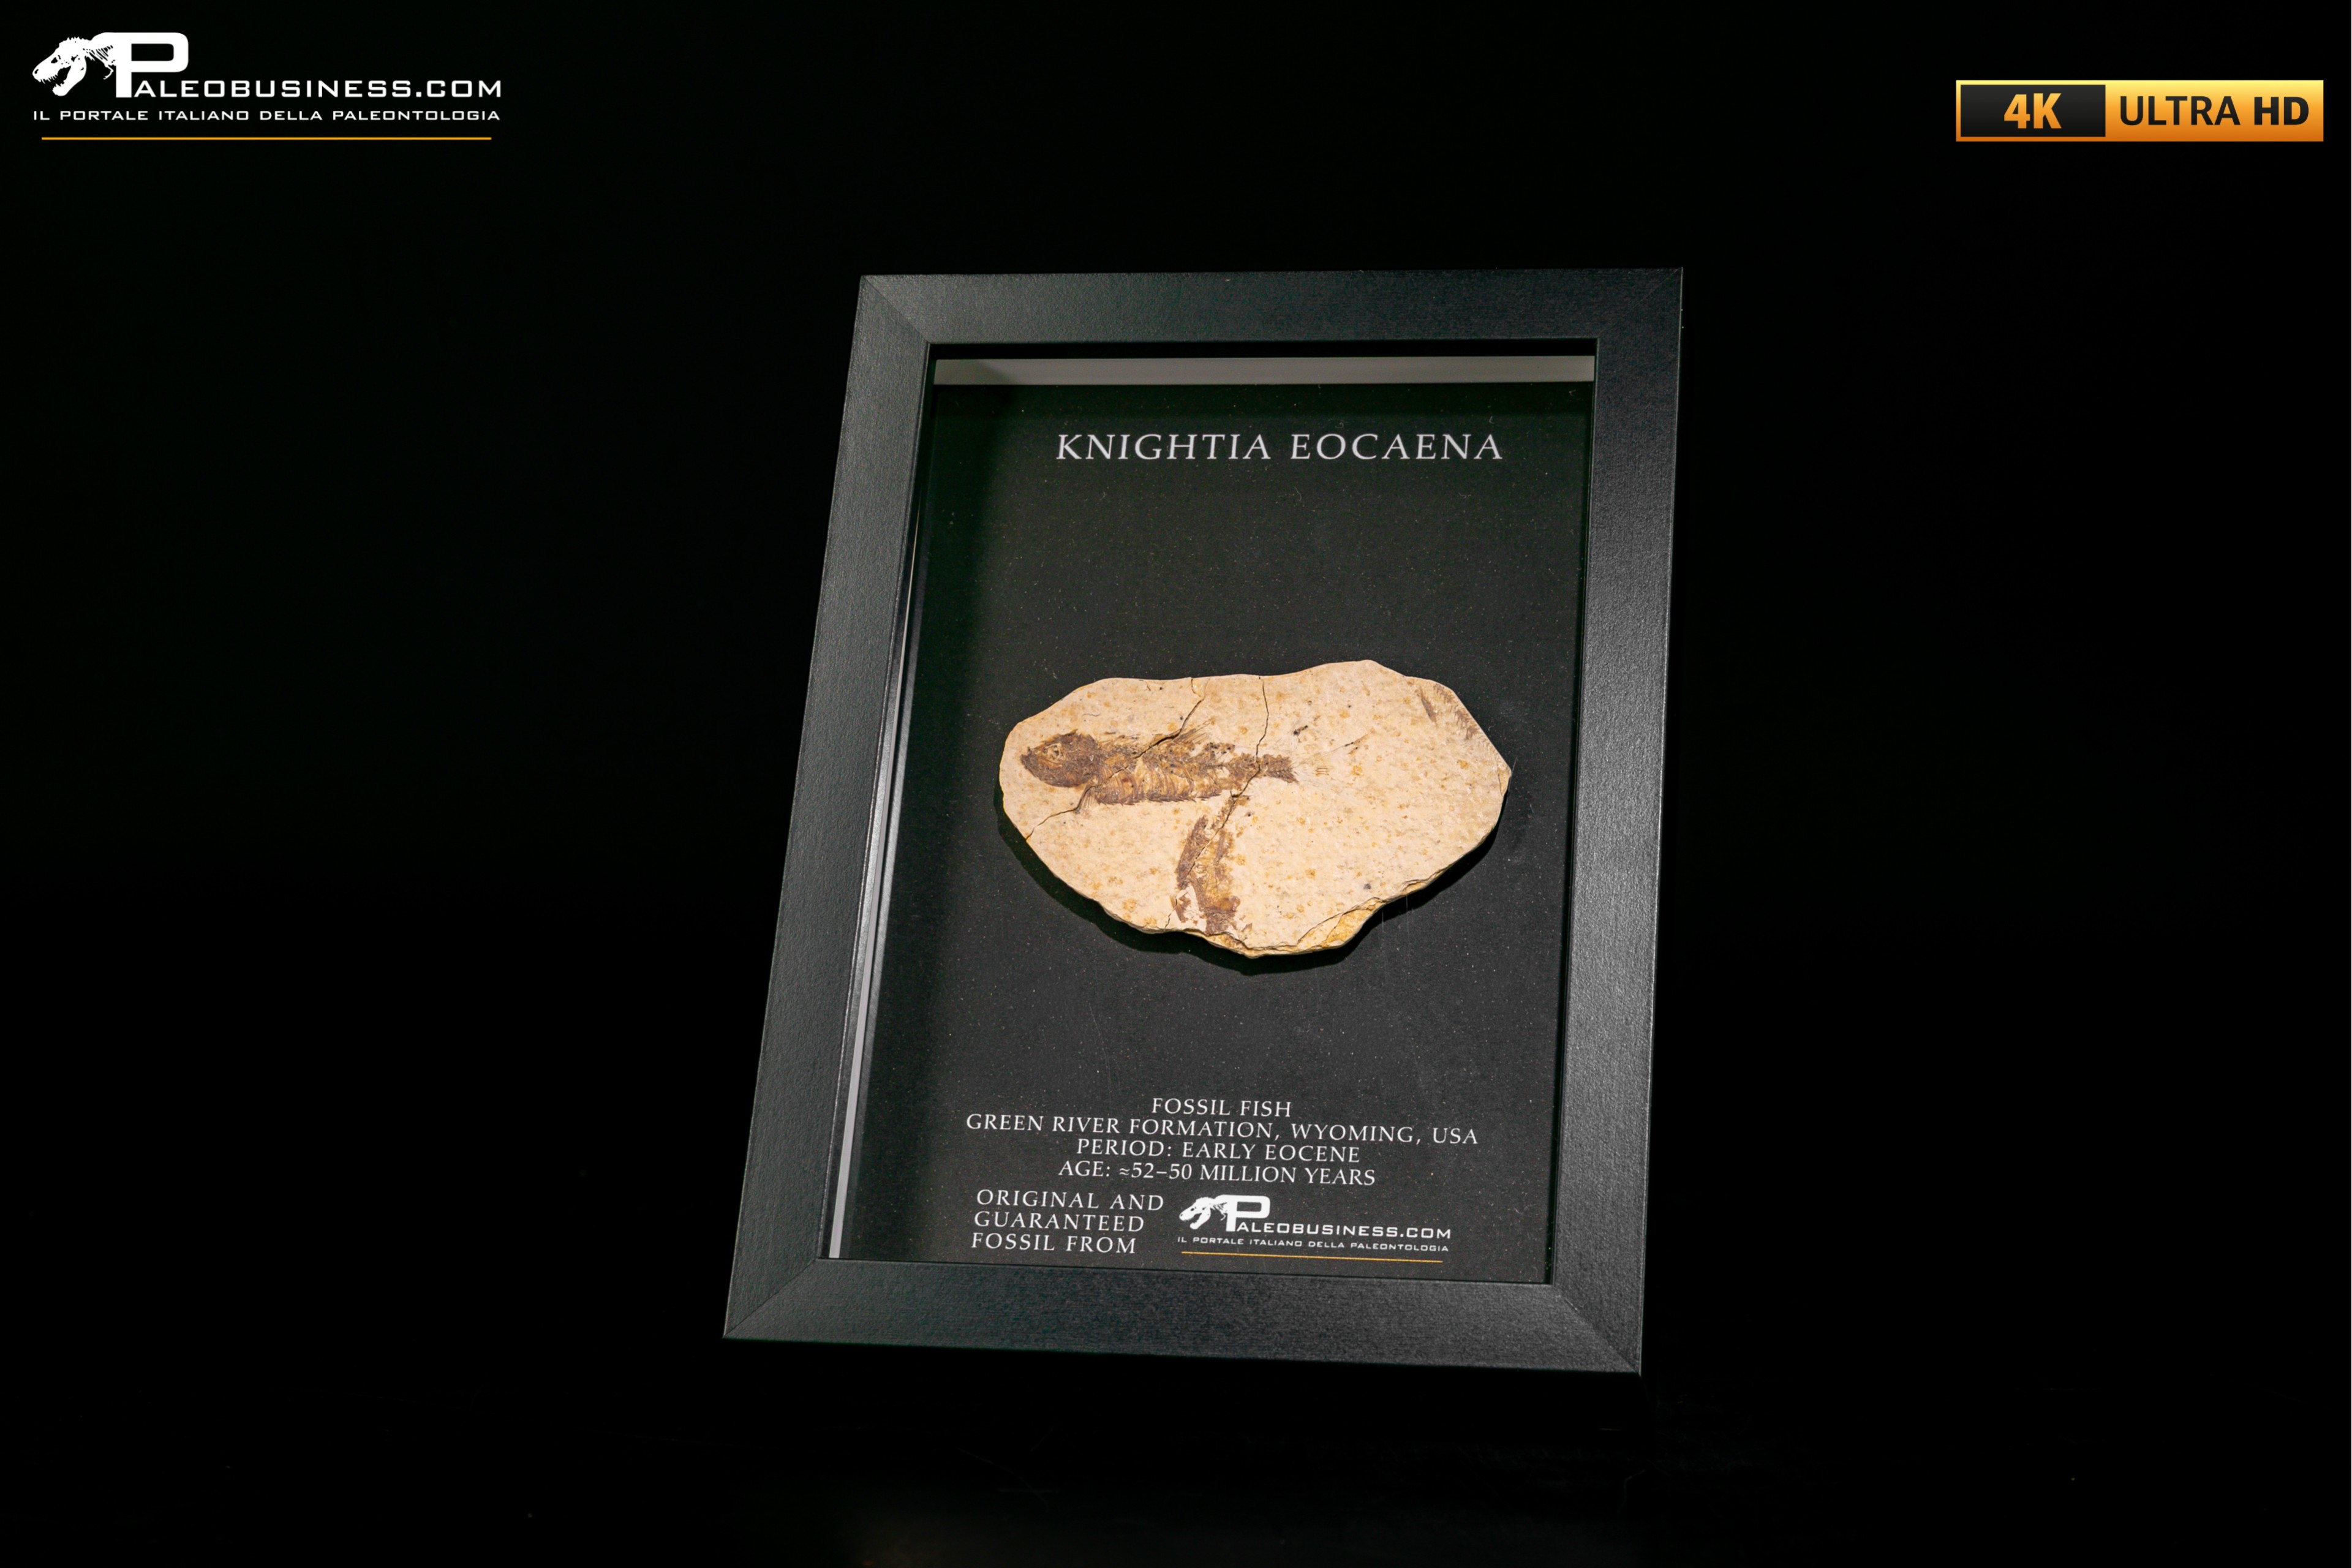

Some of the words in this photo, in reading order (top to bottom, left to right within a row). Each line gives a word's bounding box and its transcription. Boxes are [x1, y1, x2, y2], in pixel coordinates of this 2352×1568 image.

[1055, 433, 1272, 461] KNIGHTIA
[1290, 433, 1503, 461] EOCAENA
[1151, 1097, 1231, 1116] FOSSIL
[1240, 1099, 1292, 1118] FISH
[966, 1113, 1044, 1132] GREEN
[1052, 1115, 1120, 1134] RIVER
[1129, 1118, 1280, 1141] FORMATION,
[1291, 1122, 1422, 1145] WYOMING,
[1432, 1126, 1479, 1145] USA
[1076, 1137, 1172, 1158] PERIOD:
[1182, 1141, 1257, 1160] EARLY
[1265, 1143, 1360, 1164] EOCENE
[1058, 1159, 1111, 1178] AGE:
[1199, 1163, 1297, 1183] MILLION
[1304, 1167, 1376, 1186] YEARS
[976, 1188, 1100, 1210] ORIGINAL
[1109, 1193, 1164, 1212] AND
[974, 1210, 1145, 1233] GUARANTEED
[970, 1231, 1056, 1251] FOSSIL
[1065, 1234, 1137, 1254] FROM
[1193, 1237, 1245, 1245] PORTALE
[1249, 1238, 1303, 1247] ITALIANO
[1308, 1240, 1345, 1249] DELLA
[1350, 1242, 1449, 1252] PALEONTOLOGIA
